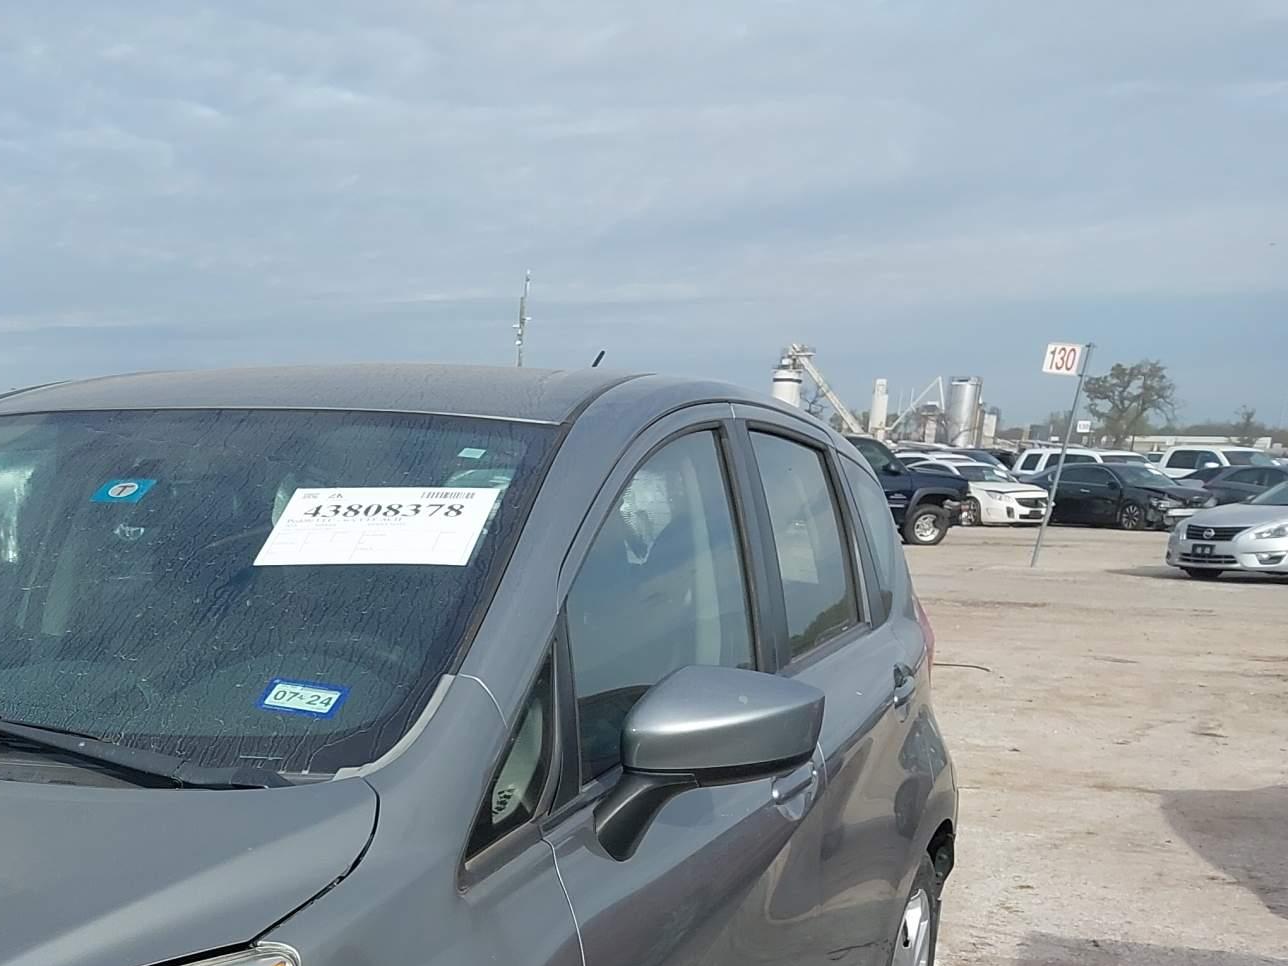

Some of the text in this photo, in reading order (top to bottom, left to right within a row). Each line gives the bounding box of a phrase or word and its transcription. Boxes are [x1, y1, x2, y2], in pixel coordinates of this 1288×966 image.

[1048, 347, 1077, 371] 130
[303, 503, 465, 518] 43808378
[273, 690, 333, 707] 07 24
